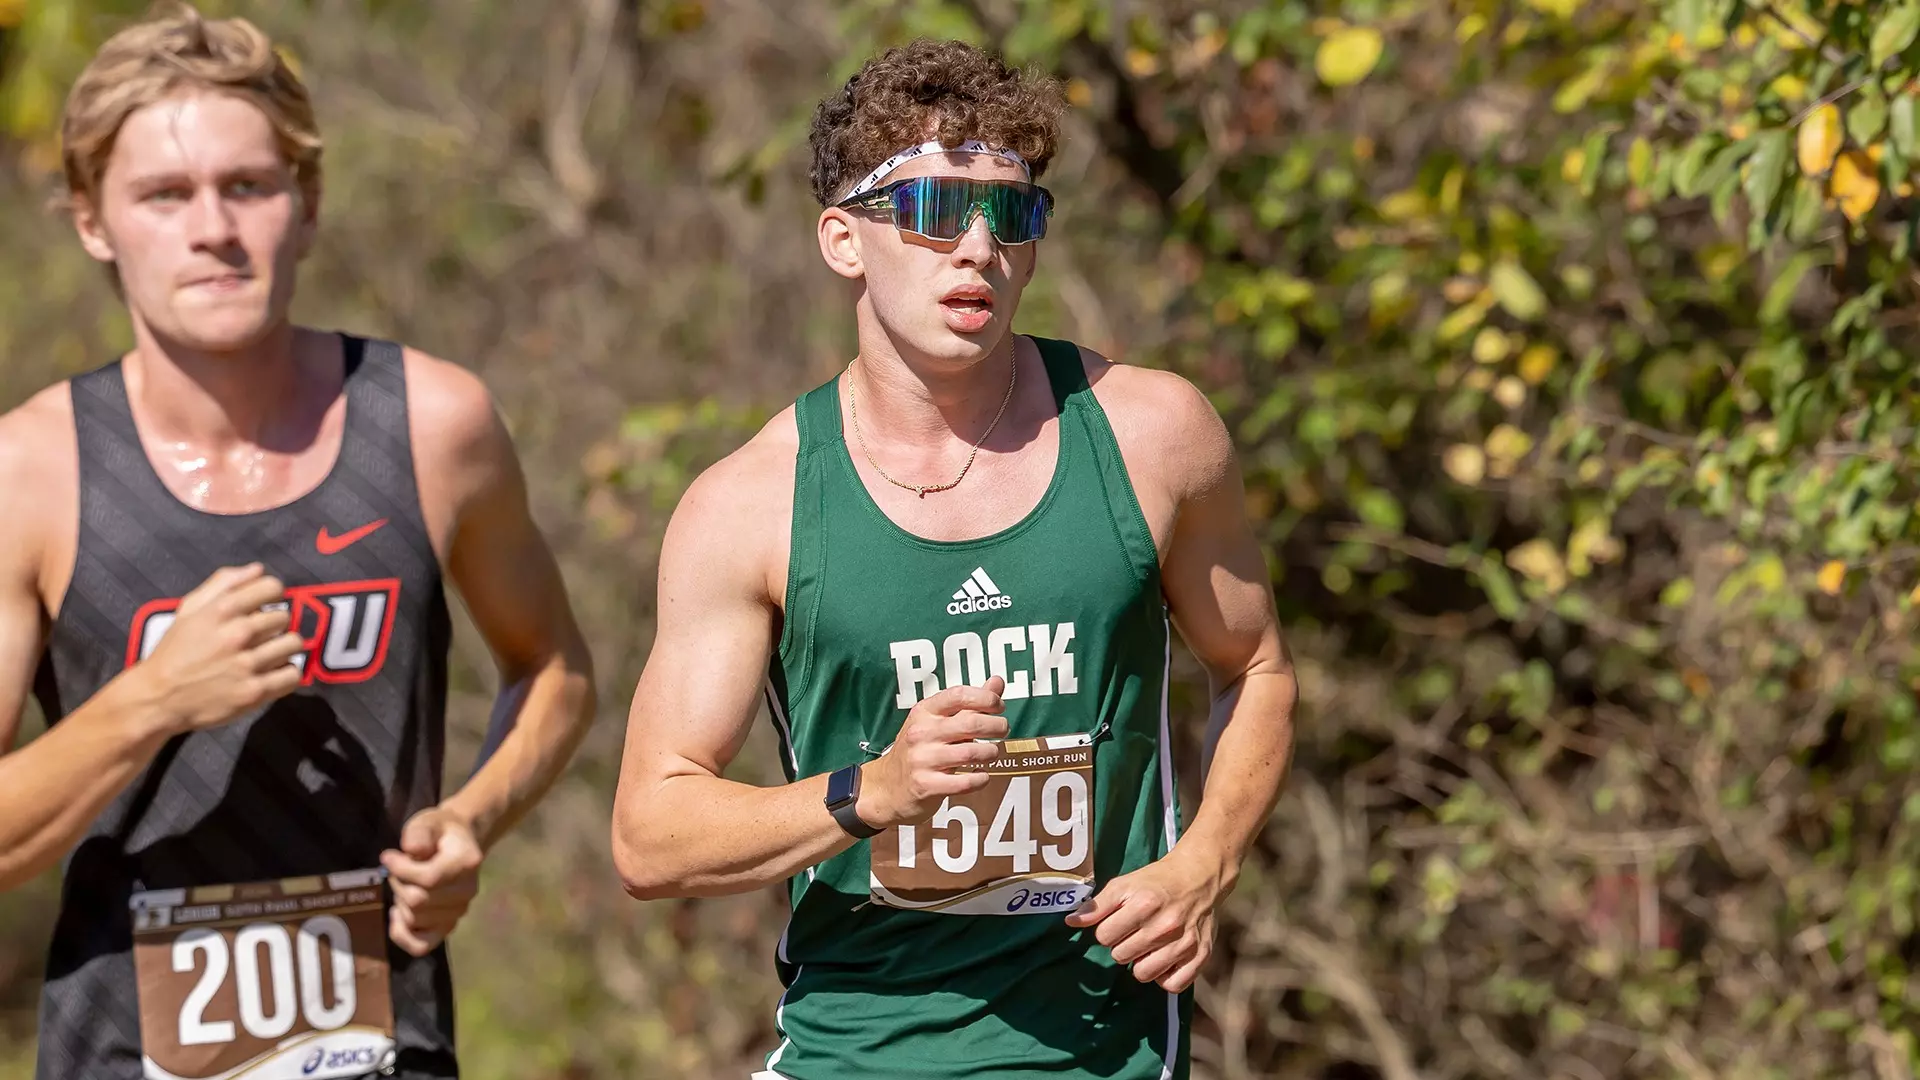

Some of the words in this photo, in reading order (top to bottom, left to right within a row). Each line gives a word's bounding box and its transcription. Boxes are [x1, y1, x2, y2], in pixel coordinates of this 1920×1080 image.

[946, 594, 1012, 615] adidas
[889, 622, 1078, 709] ROCK
[1022, 755, 1060, 767] SHORT
[1063, 753, 1087, 763] RUN
[172, 914, 357, 1045] 200
